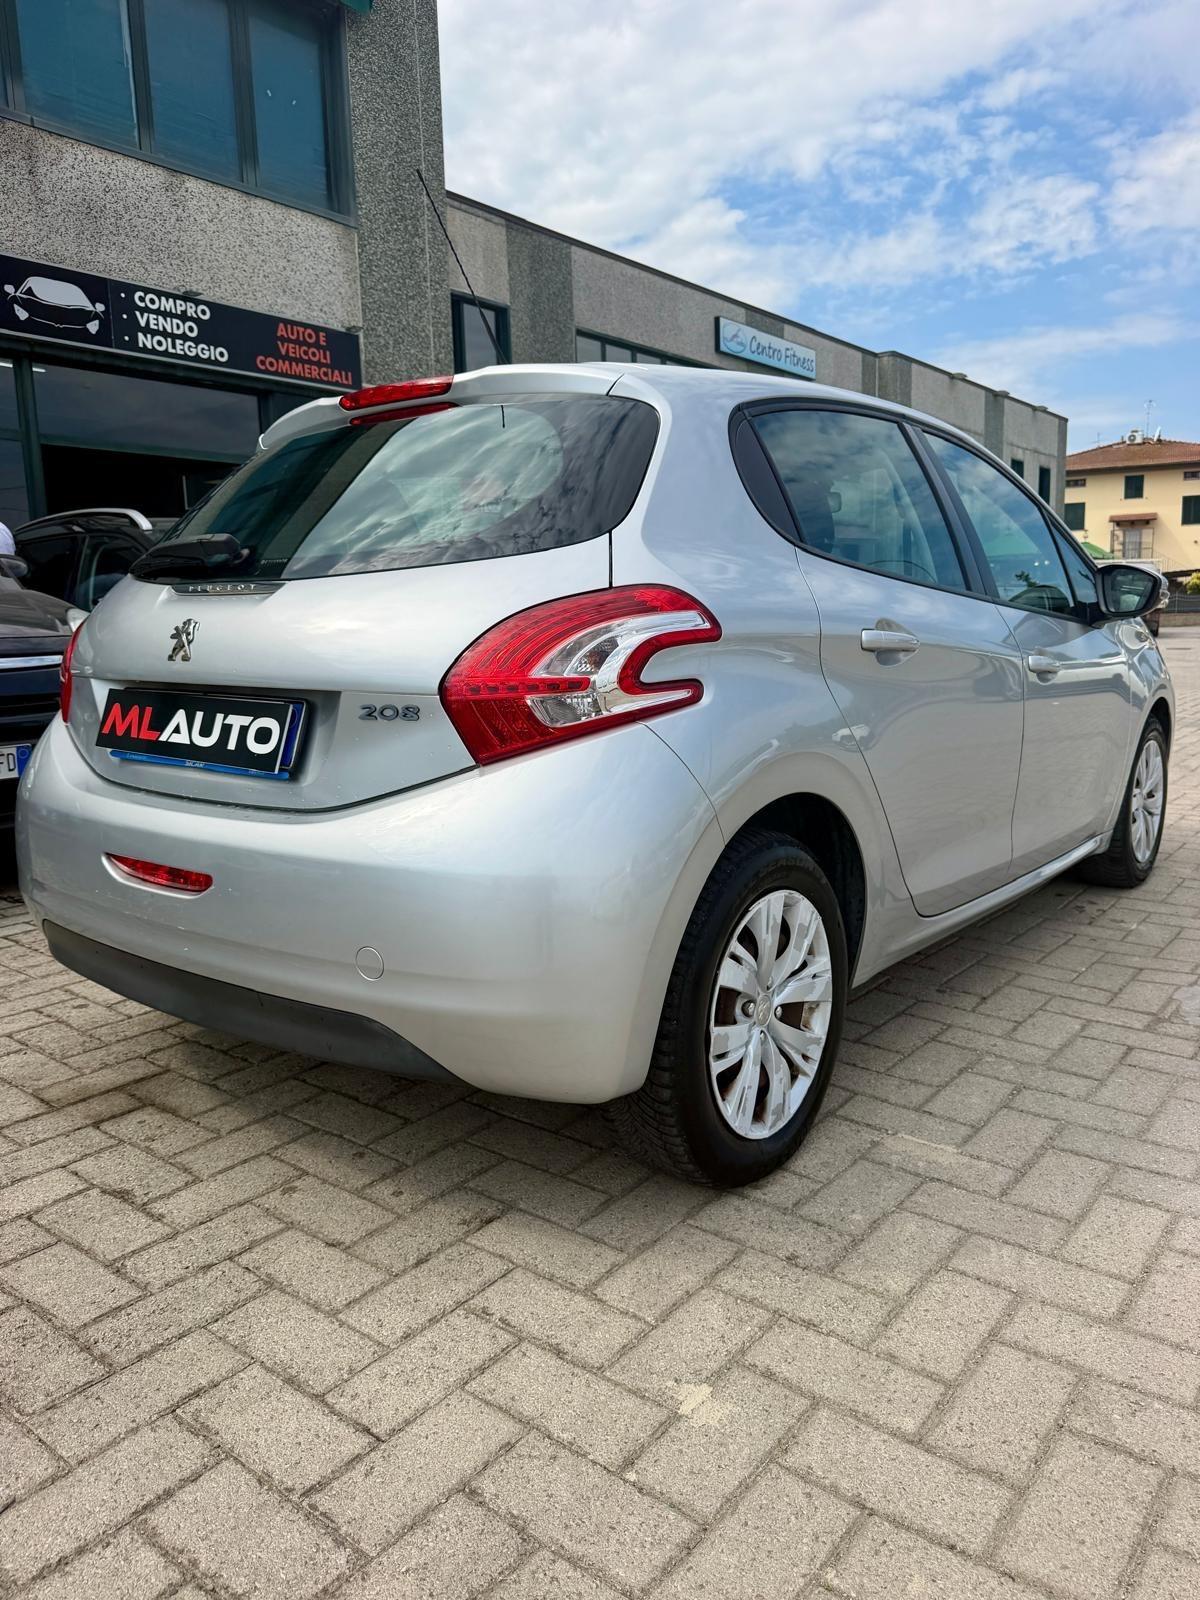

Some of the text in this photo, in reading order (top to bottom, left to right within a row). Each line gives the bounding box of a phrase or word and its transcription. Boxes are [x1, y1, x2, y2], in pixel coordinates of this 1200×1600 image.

[134, 291, 211, 320] COMPRO
[134, 310, 198, 337] VENDO
[276, 322, 327, 346] AUTO E
[137, 331, 229, 362] NOLEGGIO
[276, 341, 331, 364] VEICOLI
[748, 335, 814, 373] Centro Fitness
[256, 355, 353, 385] COMMERCIALI
[188, 583, 257, 593] PEUGEOT
[358, 704, 420, 721] 208
